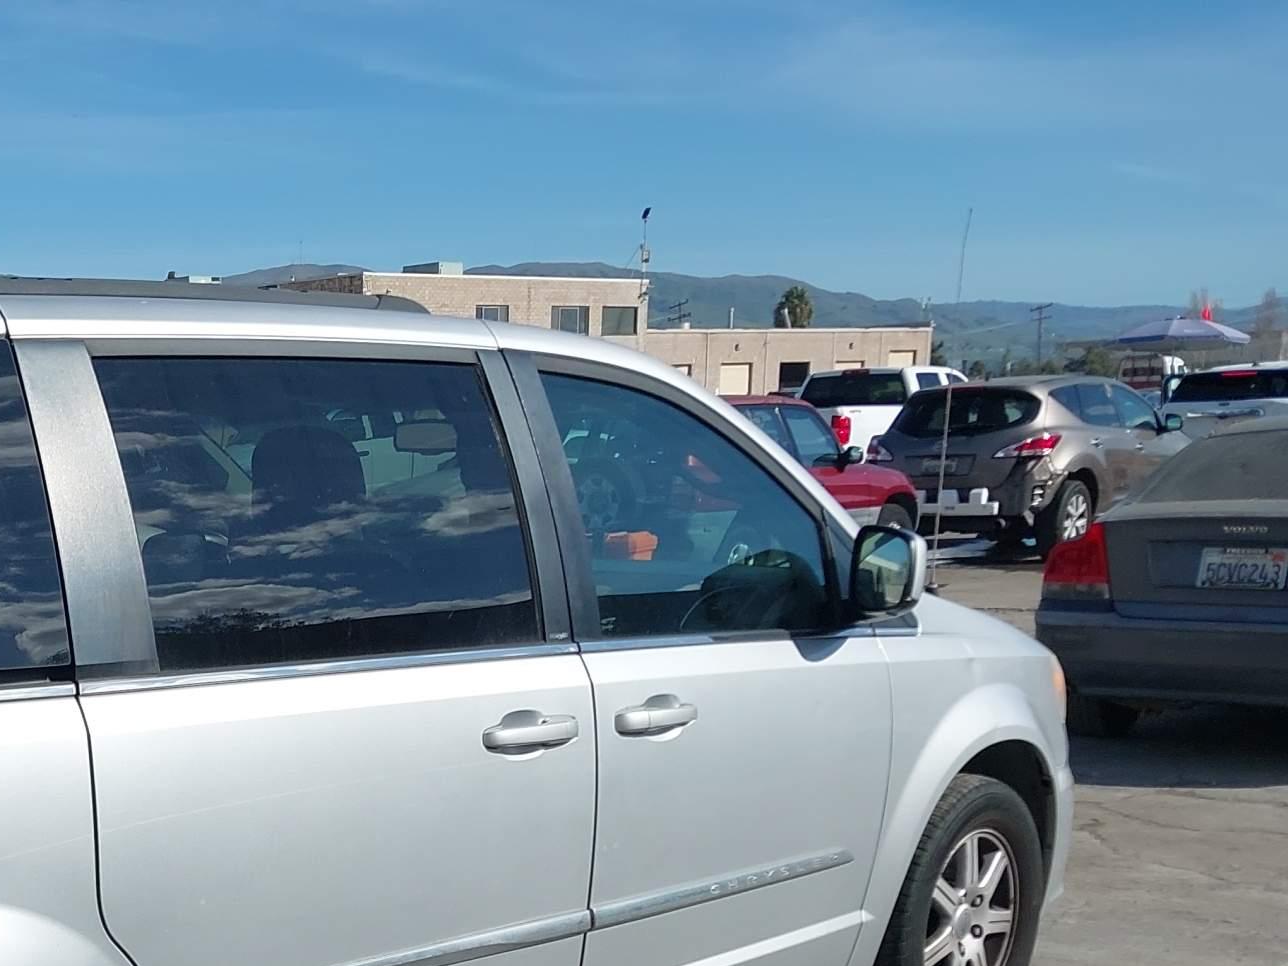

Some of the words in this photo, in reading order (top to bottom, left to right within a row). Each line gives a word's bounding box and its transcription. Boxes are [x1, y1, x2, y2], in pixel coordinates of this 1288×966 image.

[1223, 525, 1269, 534] VOLVO
[1206, 562, 1281, 583] 5CVC243
[710, 854, 840, 895] CHRYSLER
